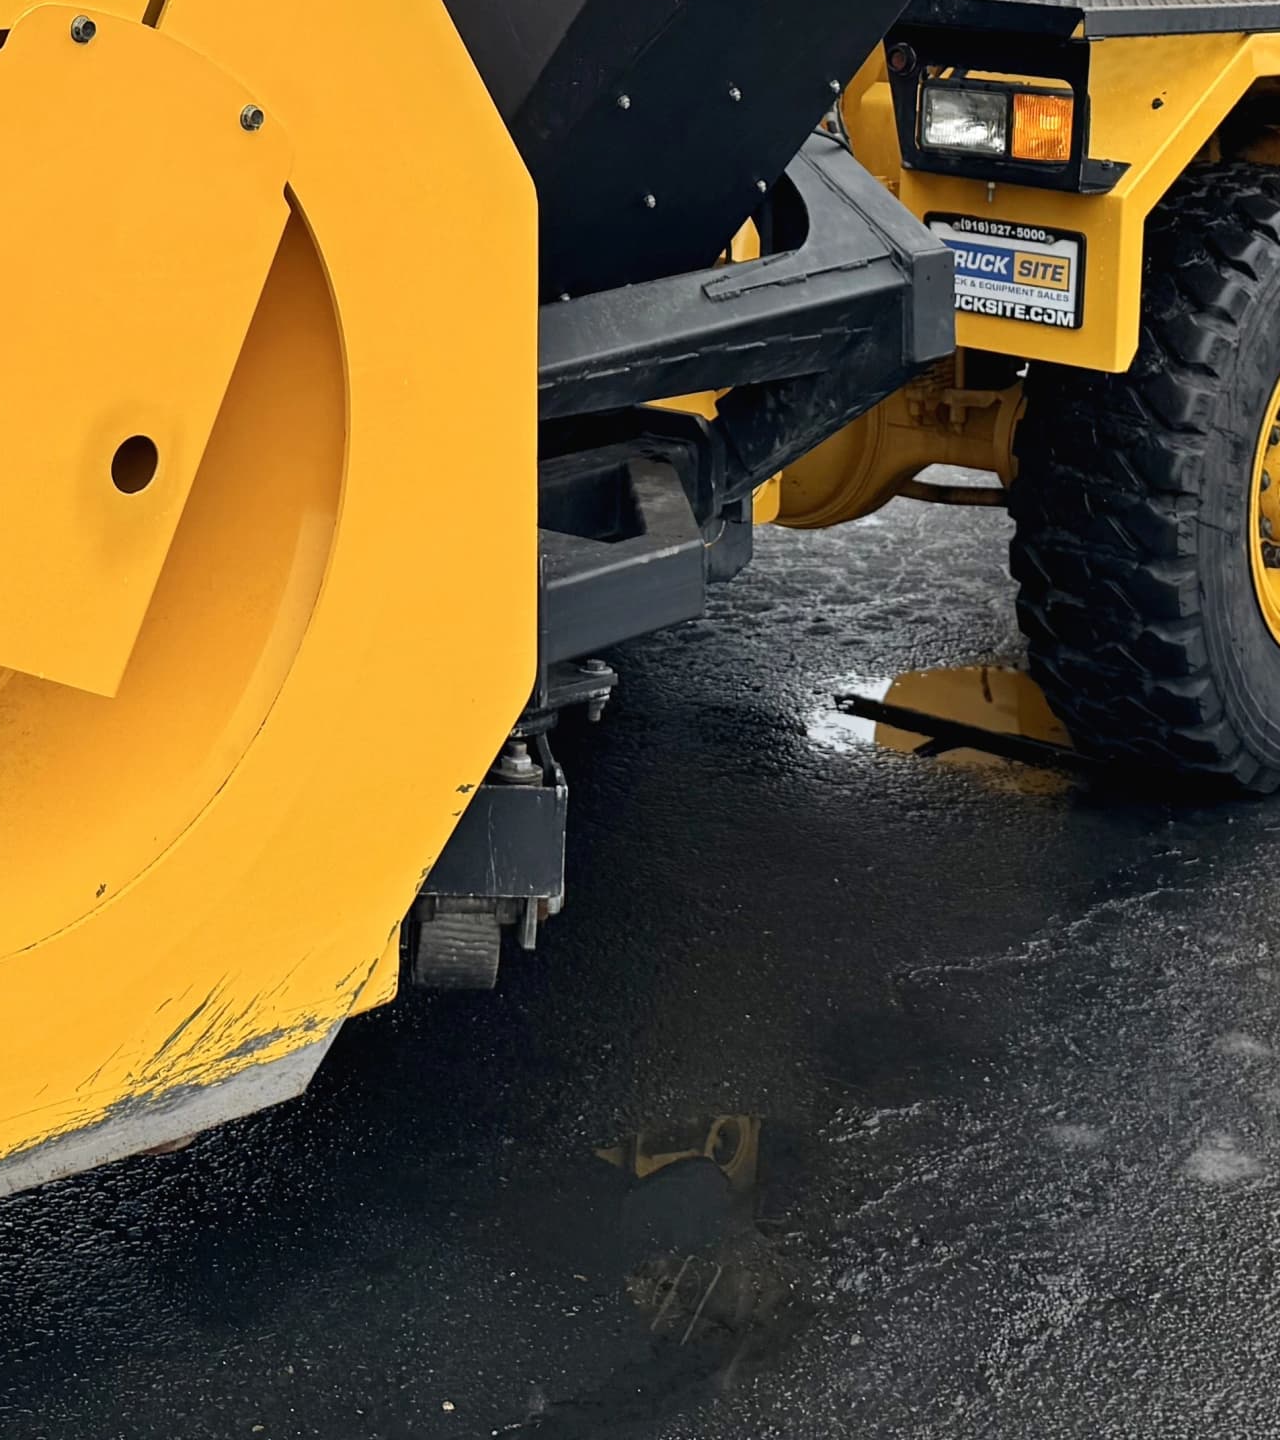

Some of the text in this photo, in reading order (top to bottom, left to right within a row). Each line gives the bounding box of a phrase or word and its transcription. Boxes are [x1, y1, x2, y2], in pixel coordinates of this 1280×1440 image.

[954, 249, 1064, 282] RUCK SITE
[979, 281, 1034, 296] EQUIPMENT
[1037, 290, 1069, 303] SALES
